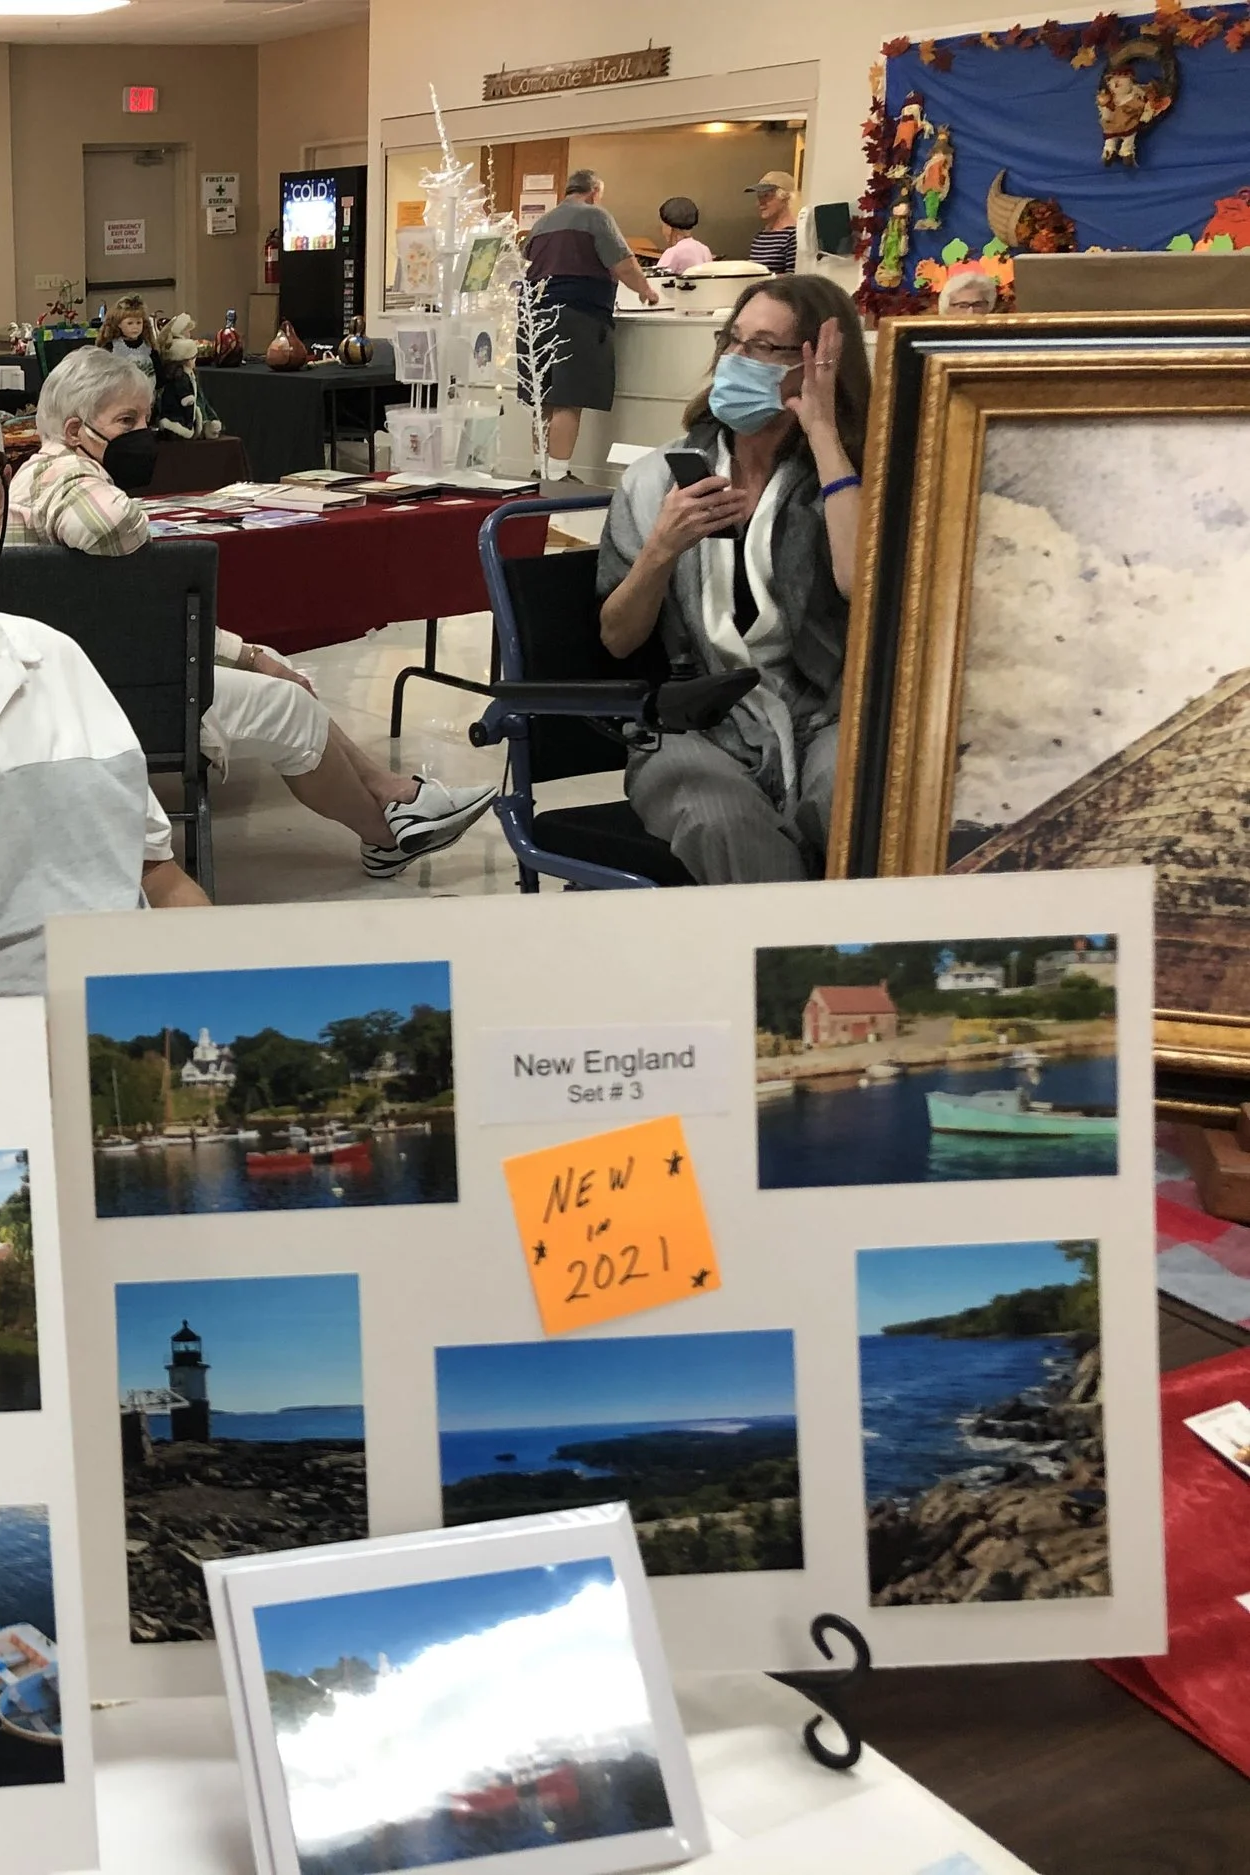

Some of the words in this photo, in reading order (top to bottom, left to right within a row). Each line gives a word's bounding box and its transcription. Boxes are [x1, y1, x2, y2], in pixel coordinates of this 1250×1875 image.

[593, 58, 632, 83] Hall
[292, 182, 328, 201] COLD
[514, 1054, 575, 1077] New
[584, 1045, 695, 1077] England
[567, 1084, 604, 1104] Set
[610, 1083, 623, 1101] #
[630, 1081, 644, 1101] 3
[543, 1156, 635, 1224] NEW
[565, 1235, 670, 1303] 2021
